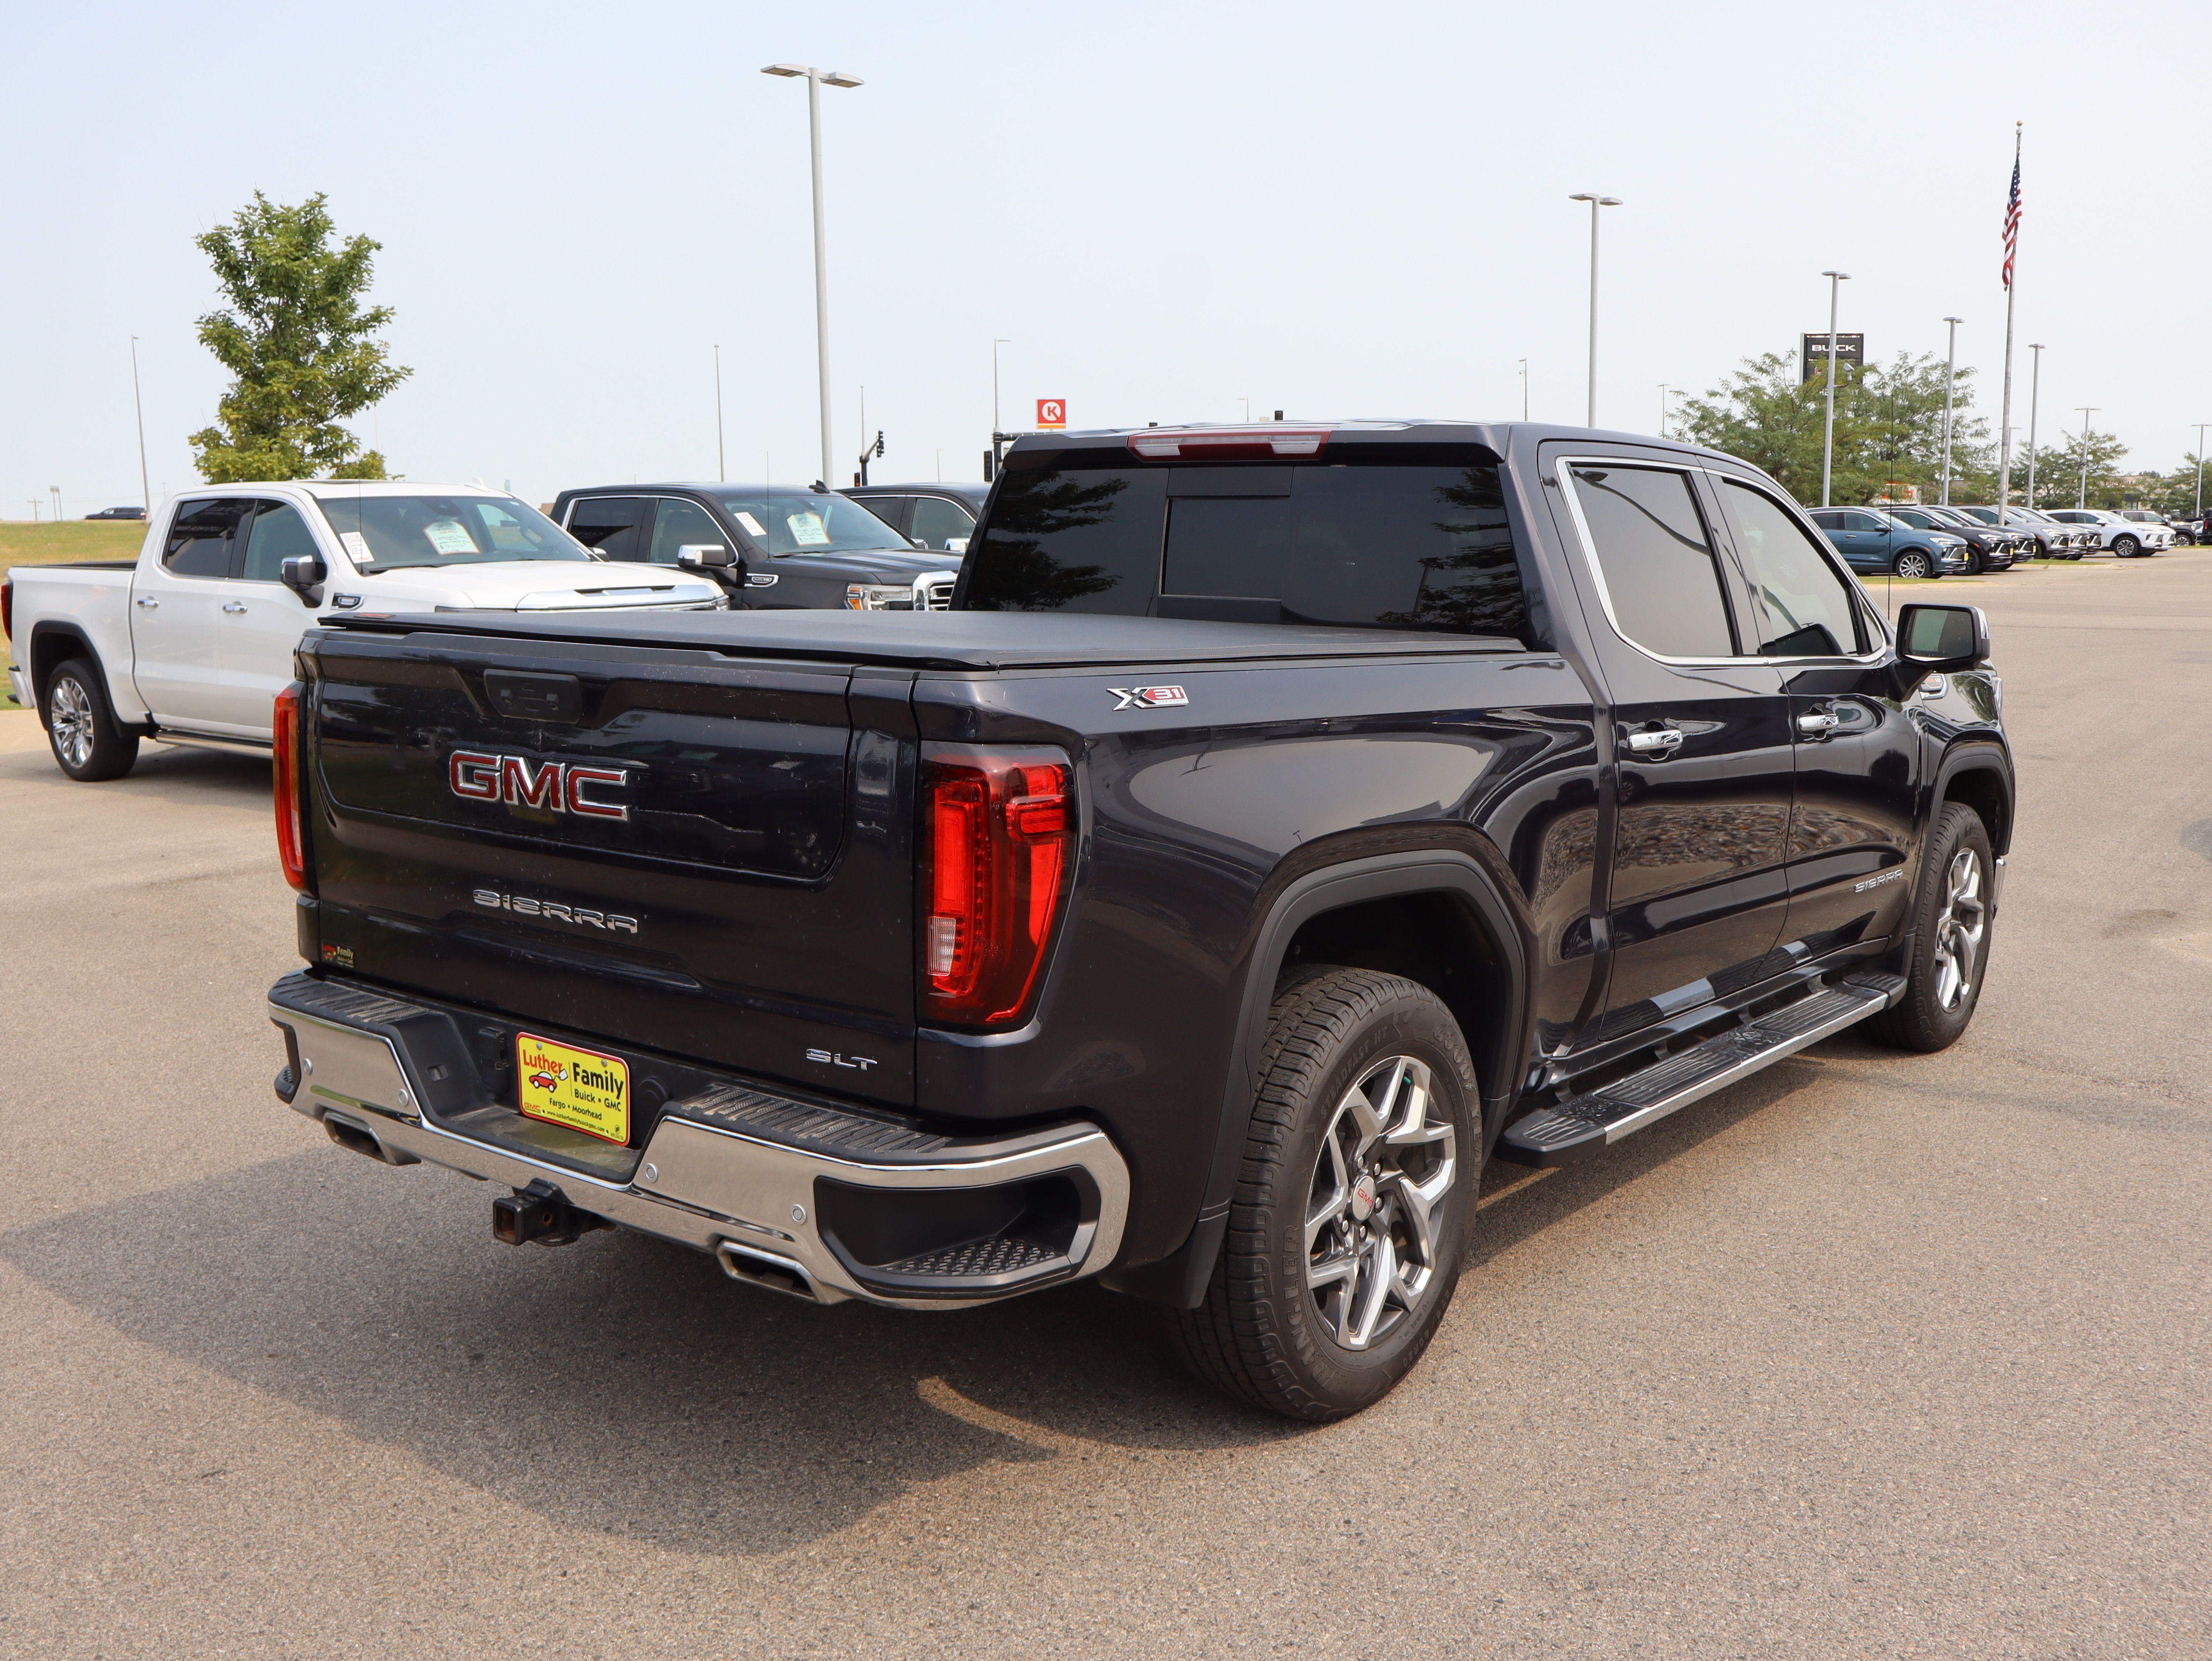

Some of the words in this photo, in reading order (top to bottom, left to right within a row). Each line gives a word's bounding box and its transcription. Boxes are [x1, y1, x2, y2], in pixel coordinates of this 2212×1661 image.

[1106, 685, 1189, 711] X31
[449, 750, 630, 822] GMC
[1854, 869, 1903, 893] SIERRA
[473, 889, 638, 933] SIERRA
[338, 946, 353, 959] Family
[523, 1049, 563, 1073] Luther
[806, 1049, 877, 1071] SLT
[1320, 1039, 1370, 1119] STEADFAST
[1374, 1025, 1389, 1045] HT
[573, 1062, 624, 1100] Family
[524, 1102, 541, 1112] GMC
[550, 1098, 565, 1109] Fargo
[572, 1105, 602, 1120] Moorhead
[575, 1088, 595, 1103] Buick
[604, 1098, 621, 1112] GMC
[1357, 1188, 1374, 1209] GMC
